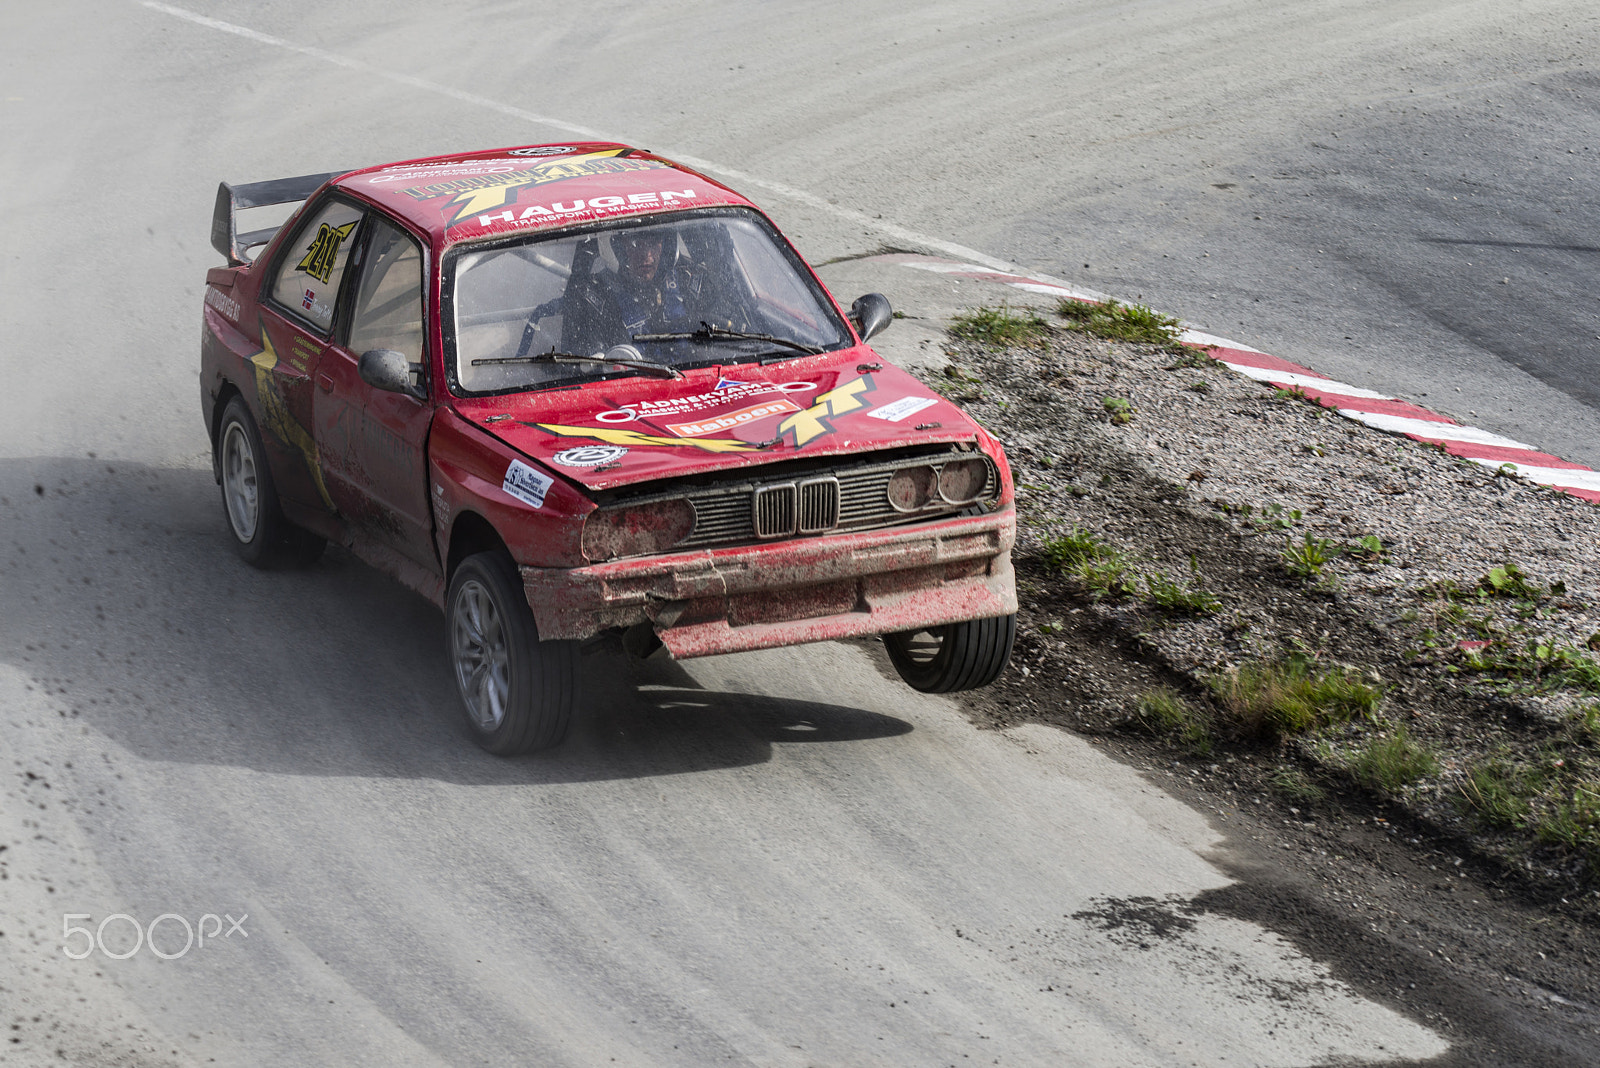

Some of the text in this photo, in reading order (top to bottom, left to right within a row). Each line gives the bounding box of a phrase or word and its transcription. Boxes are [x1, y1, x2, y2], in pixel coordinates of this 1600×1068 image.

[479, 189, 697, 227] HAUGEN
[511, 209, 591, 227] TRANSPORT
[596, 206, 605, 214] &
[608, 201, 659, 212] MASKIN
[638, 404, 690, 414] MASKIN
[704, 386, 778, 405] TRANSPORT
[680, 403, 787, 435] Naboen
